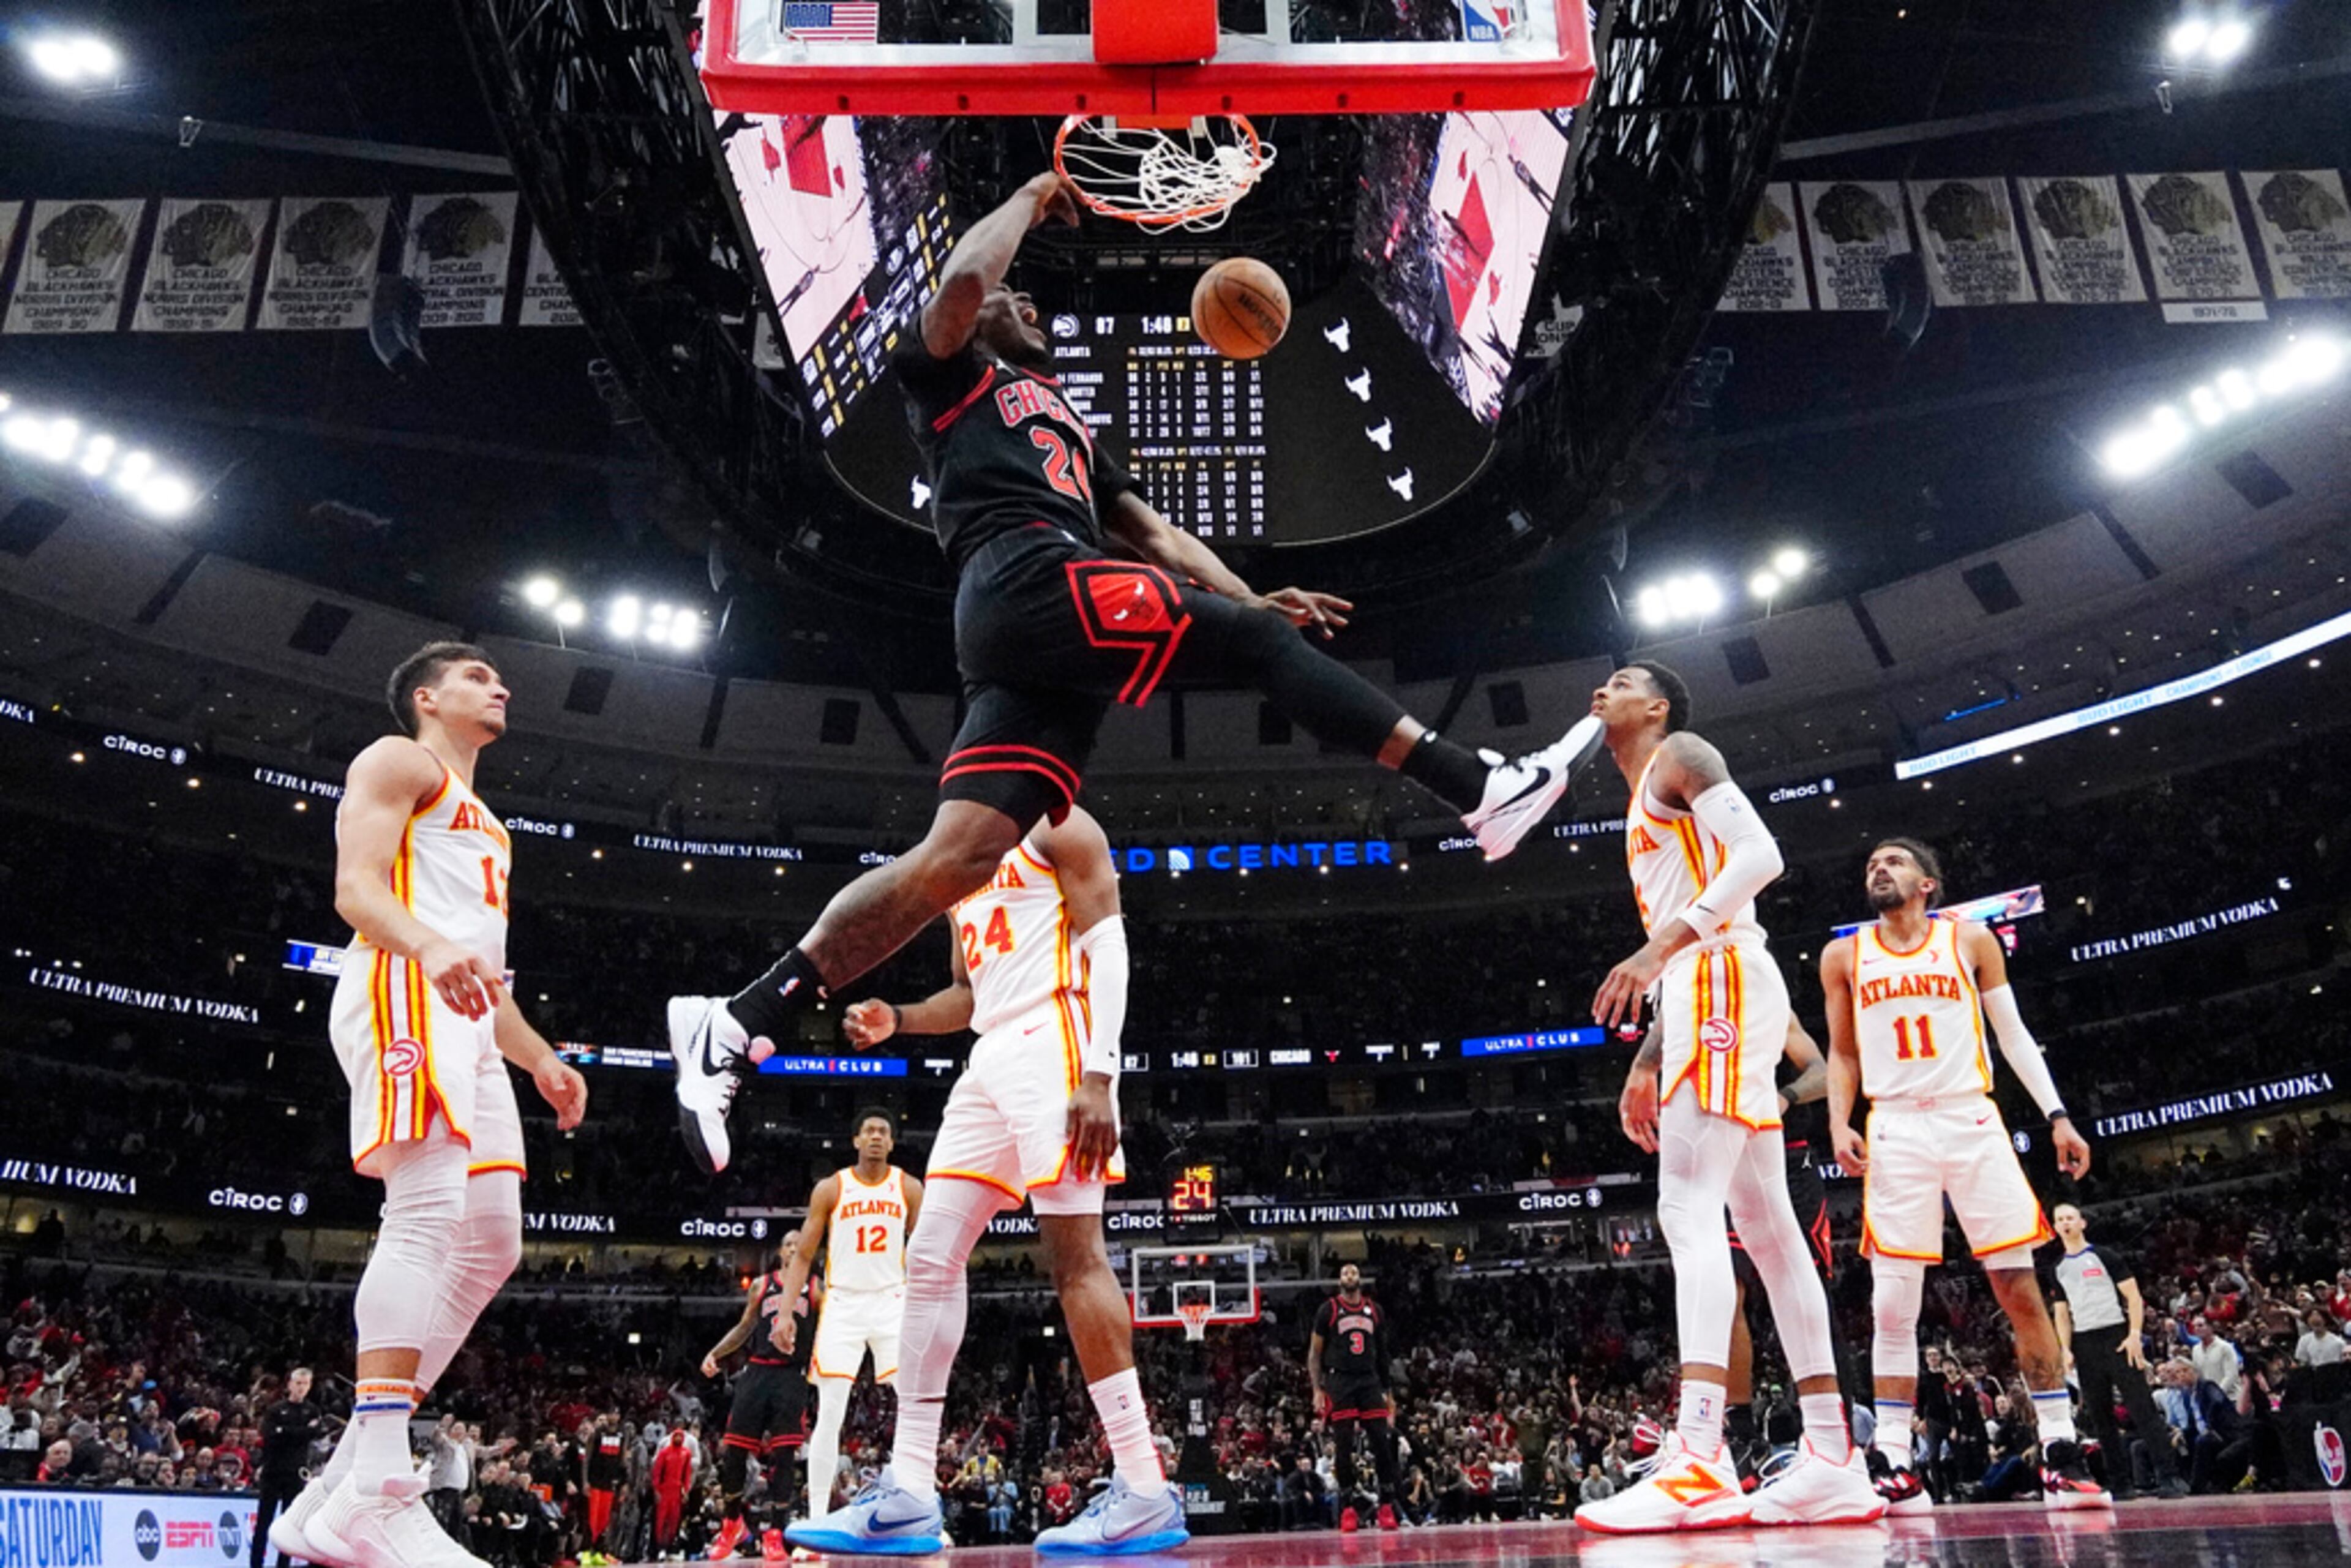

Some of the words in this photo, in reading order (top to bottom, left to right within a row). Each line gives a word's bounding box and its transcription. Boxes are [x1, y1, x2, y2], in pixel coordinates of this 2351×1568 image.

[1471, 26, 1495, 39] NBA
[430, 261, 483, 274] CHICAGO
[1054, 346, 1090, 357] ATLANTA
[2235, 651, 2272, 675] LOUNGE
[2166, 671, 2223, 697] CHAMPIONS
[0, 700, 34, 723] DKA
[2077, 707, 2107, 723] BUD
[2109, 694, 2153, 715] LIGHT
[1910, 758, 1936, 773] BUD
[1940, 746, 1977, 765] LIGHT
[254, 767, 307, 792] ULTRA
[1553, 822, 1599, 838] ULTRA
[634, 834, 681, 852] ULTRA
[682, 840, 753, 857] PREMIUM
[756, 845, 803, 861] VODKA
[1206, 841, 1392, 869] CENTER
[961, 906, 1014, 972] 24
[2071, 937, 2129, 962] ULTRA
[2131, 914, 2216, 949] PREMIUM
[2219, 896, 2279, 925] VODKA
[29, 967, 92, 996] ULTRA
[94, 981, 192, 1013] PREMIUM
[195, 999, 258, 1024] VODKA
[1860, 974, 1962, 1010] ATLANTA
[1485, 1038, 1523, 1052] ULTRA
[1536, 1032, 1580, 1047] CLUB
[1892, 1015, 1937, 1060] 11
[785, 1059, 825, 1071] ULTRA
[839, 1060, 882, 1072] CLUB
[1269, 1050, 1311, 1064] CHICAGO
[2096, 1110, 2158, 1137] ULTRA
[2159, 1087, 2257, 1125] PREMIUM
[2259, 1071, 2333, 1102] VODKA
[66, 1166, 137, 1195] VODKA
[1173, 1182, 1212, 1210] 24
[840, 1200, 901, 1220] ATLANTA
[1183, 1214, 1217, 1223] TISSOT
[1250, 1207, 1307, 1224] ULTRA
[1311, 1204, 1395, 1221] PREMIUM
[1400, 1201, 1460, 1218] VODKA
[550, 1213, 615, 1233] VODKA
[856, 1225, 888, 1254] 12
[1349, 1331, 1365, 1355] 3
[135, 1522, 160, 1544] abc
[165, 1521, 214, 1547] ESPN
[219, 1526, 242, 1546] TNT
